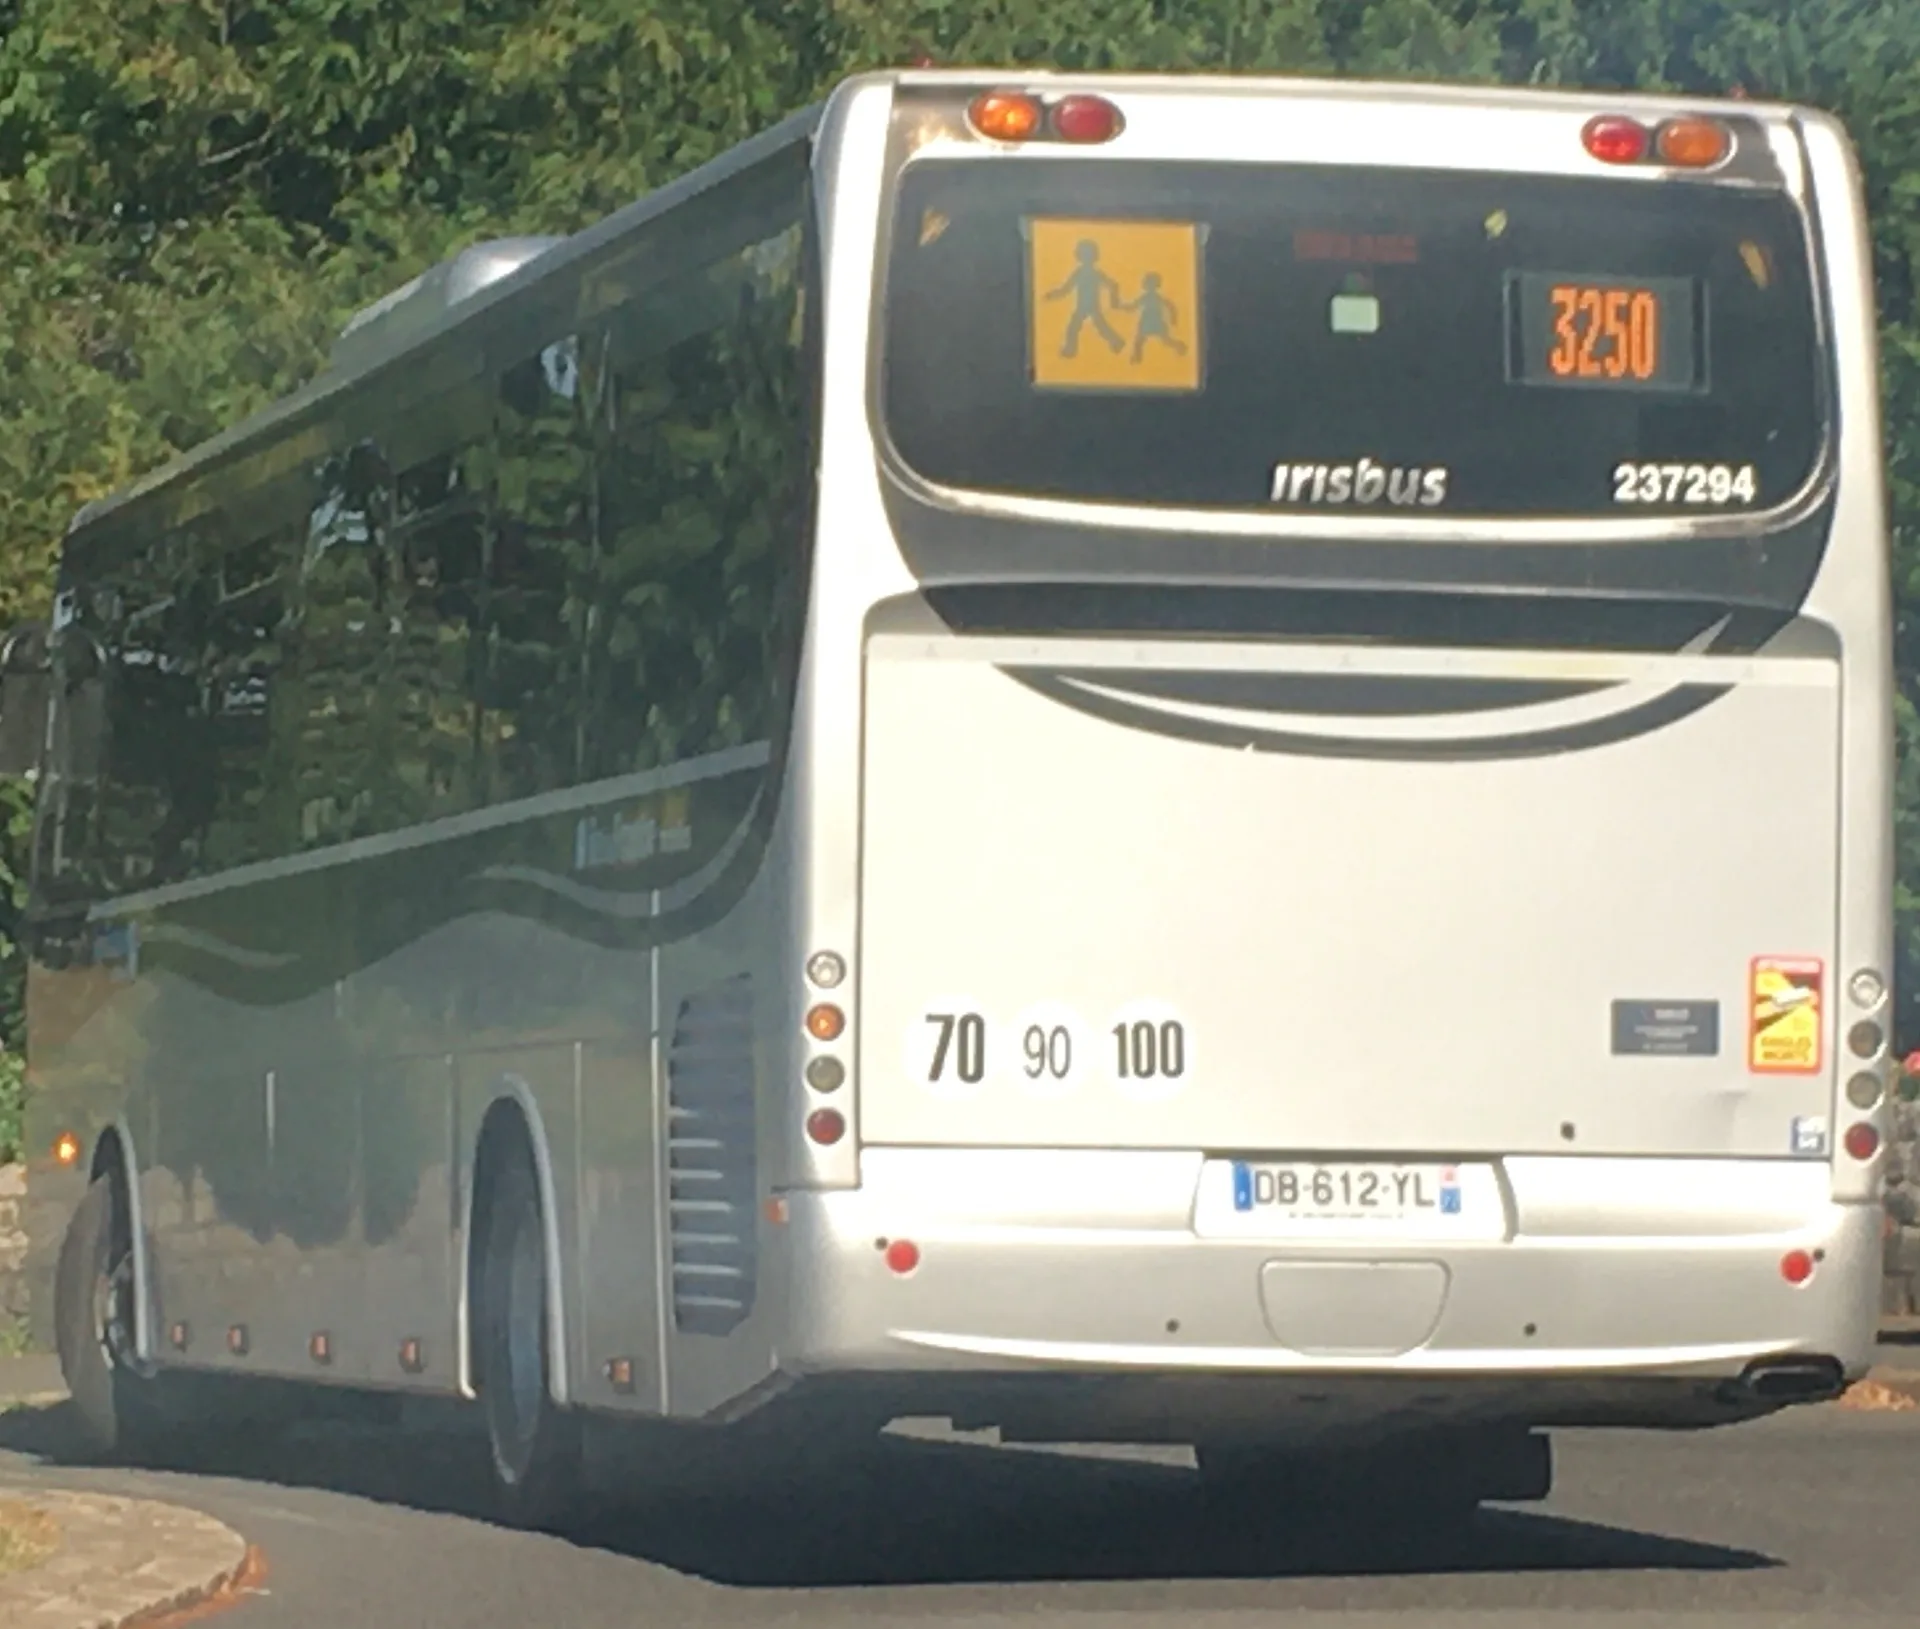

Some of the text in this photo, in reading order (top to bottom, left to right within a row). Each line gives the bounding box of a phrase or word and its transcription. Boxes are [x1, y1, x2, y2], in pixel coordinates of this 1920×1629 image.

[1549, 287, 1656, 380] 3250
[1613, 464, 1756, 504] 237294
[926, 1012, 986, 1084] 70
[1023, 1024, 1072, 1080] 90
[1112, 1019, 1186, 1080] 100
[1254, 1169, 1436, 1208] DB-612-YL
